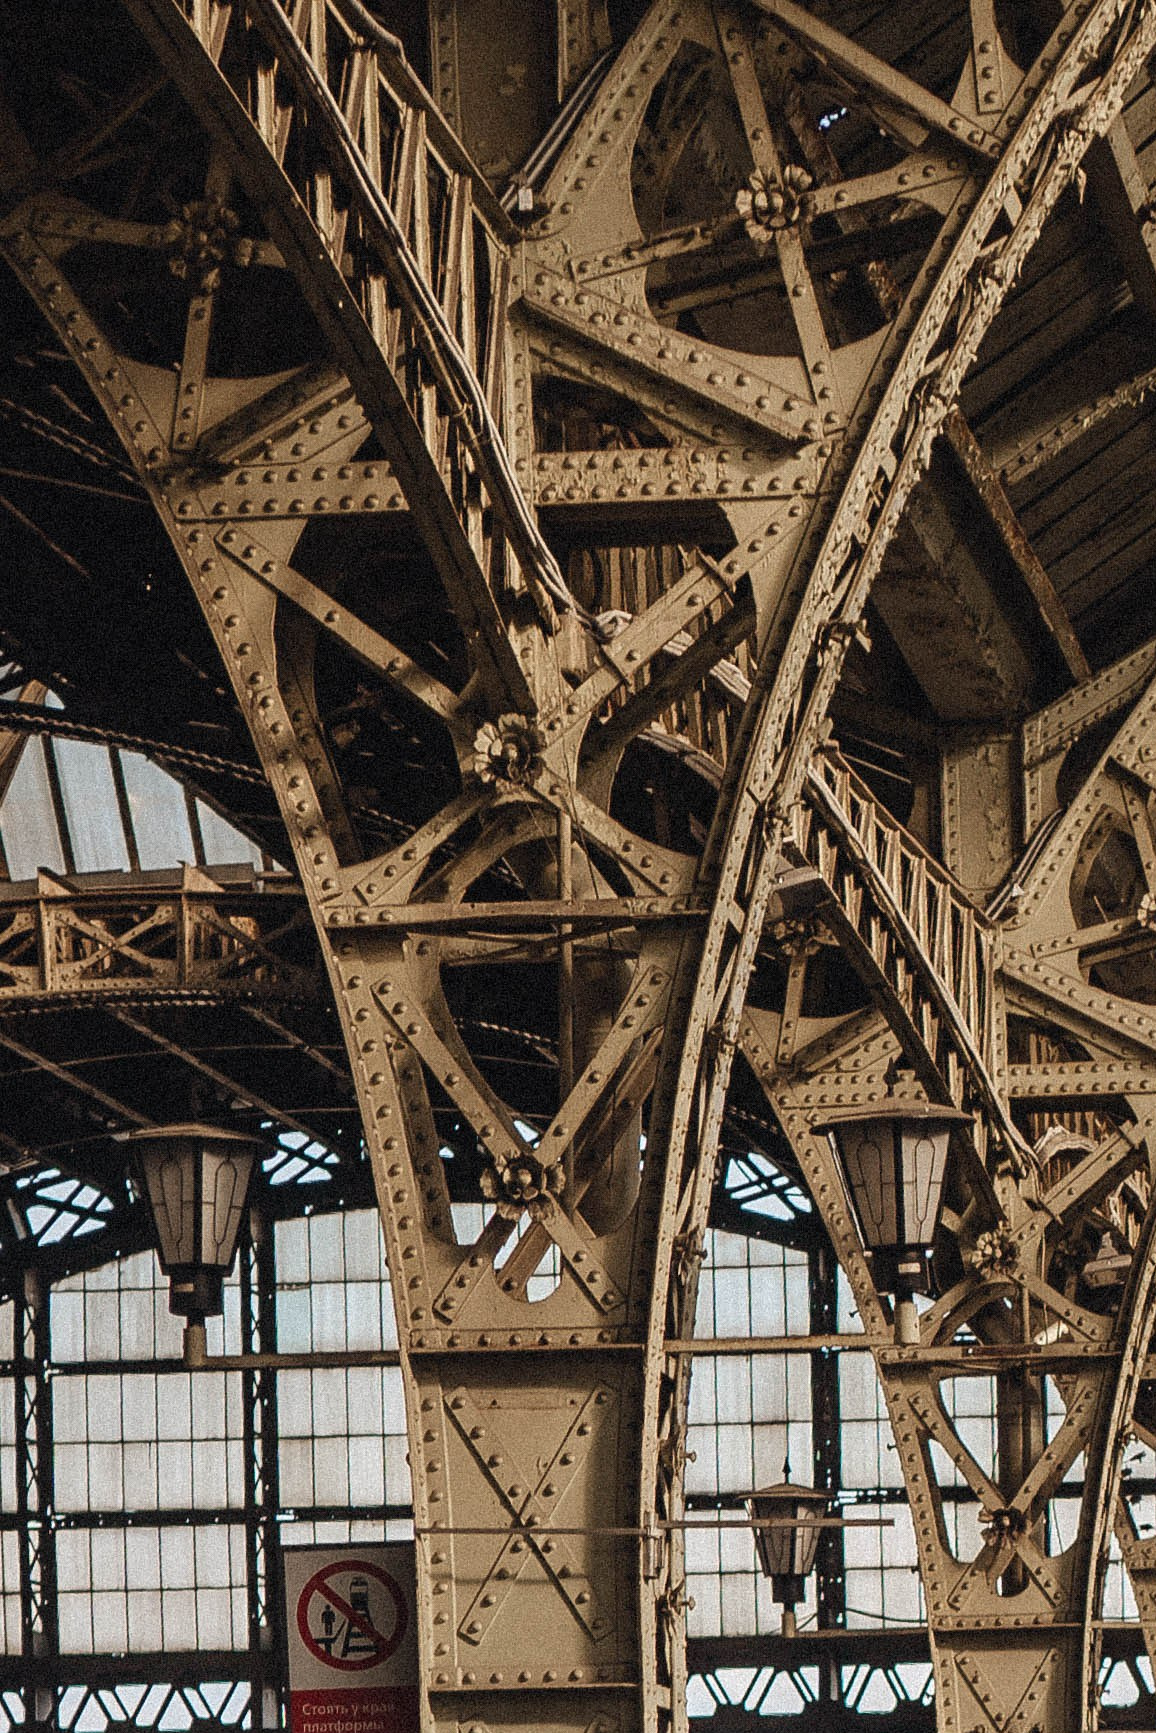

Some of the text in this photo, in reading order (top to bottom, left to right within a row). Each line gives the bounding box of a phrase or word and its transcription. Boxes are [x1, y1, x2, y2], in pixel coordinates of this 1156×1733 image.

[302, 1703, 349, 1716] Стоять
[351, 1704, 358, 1717] у
[303, 1720, 385, 1733] платформы
